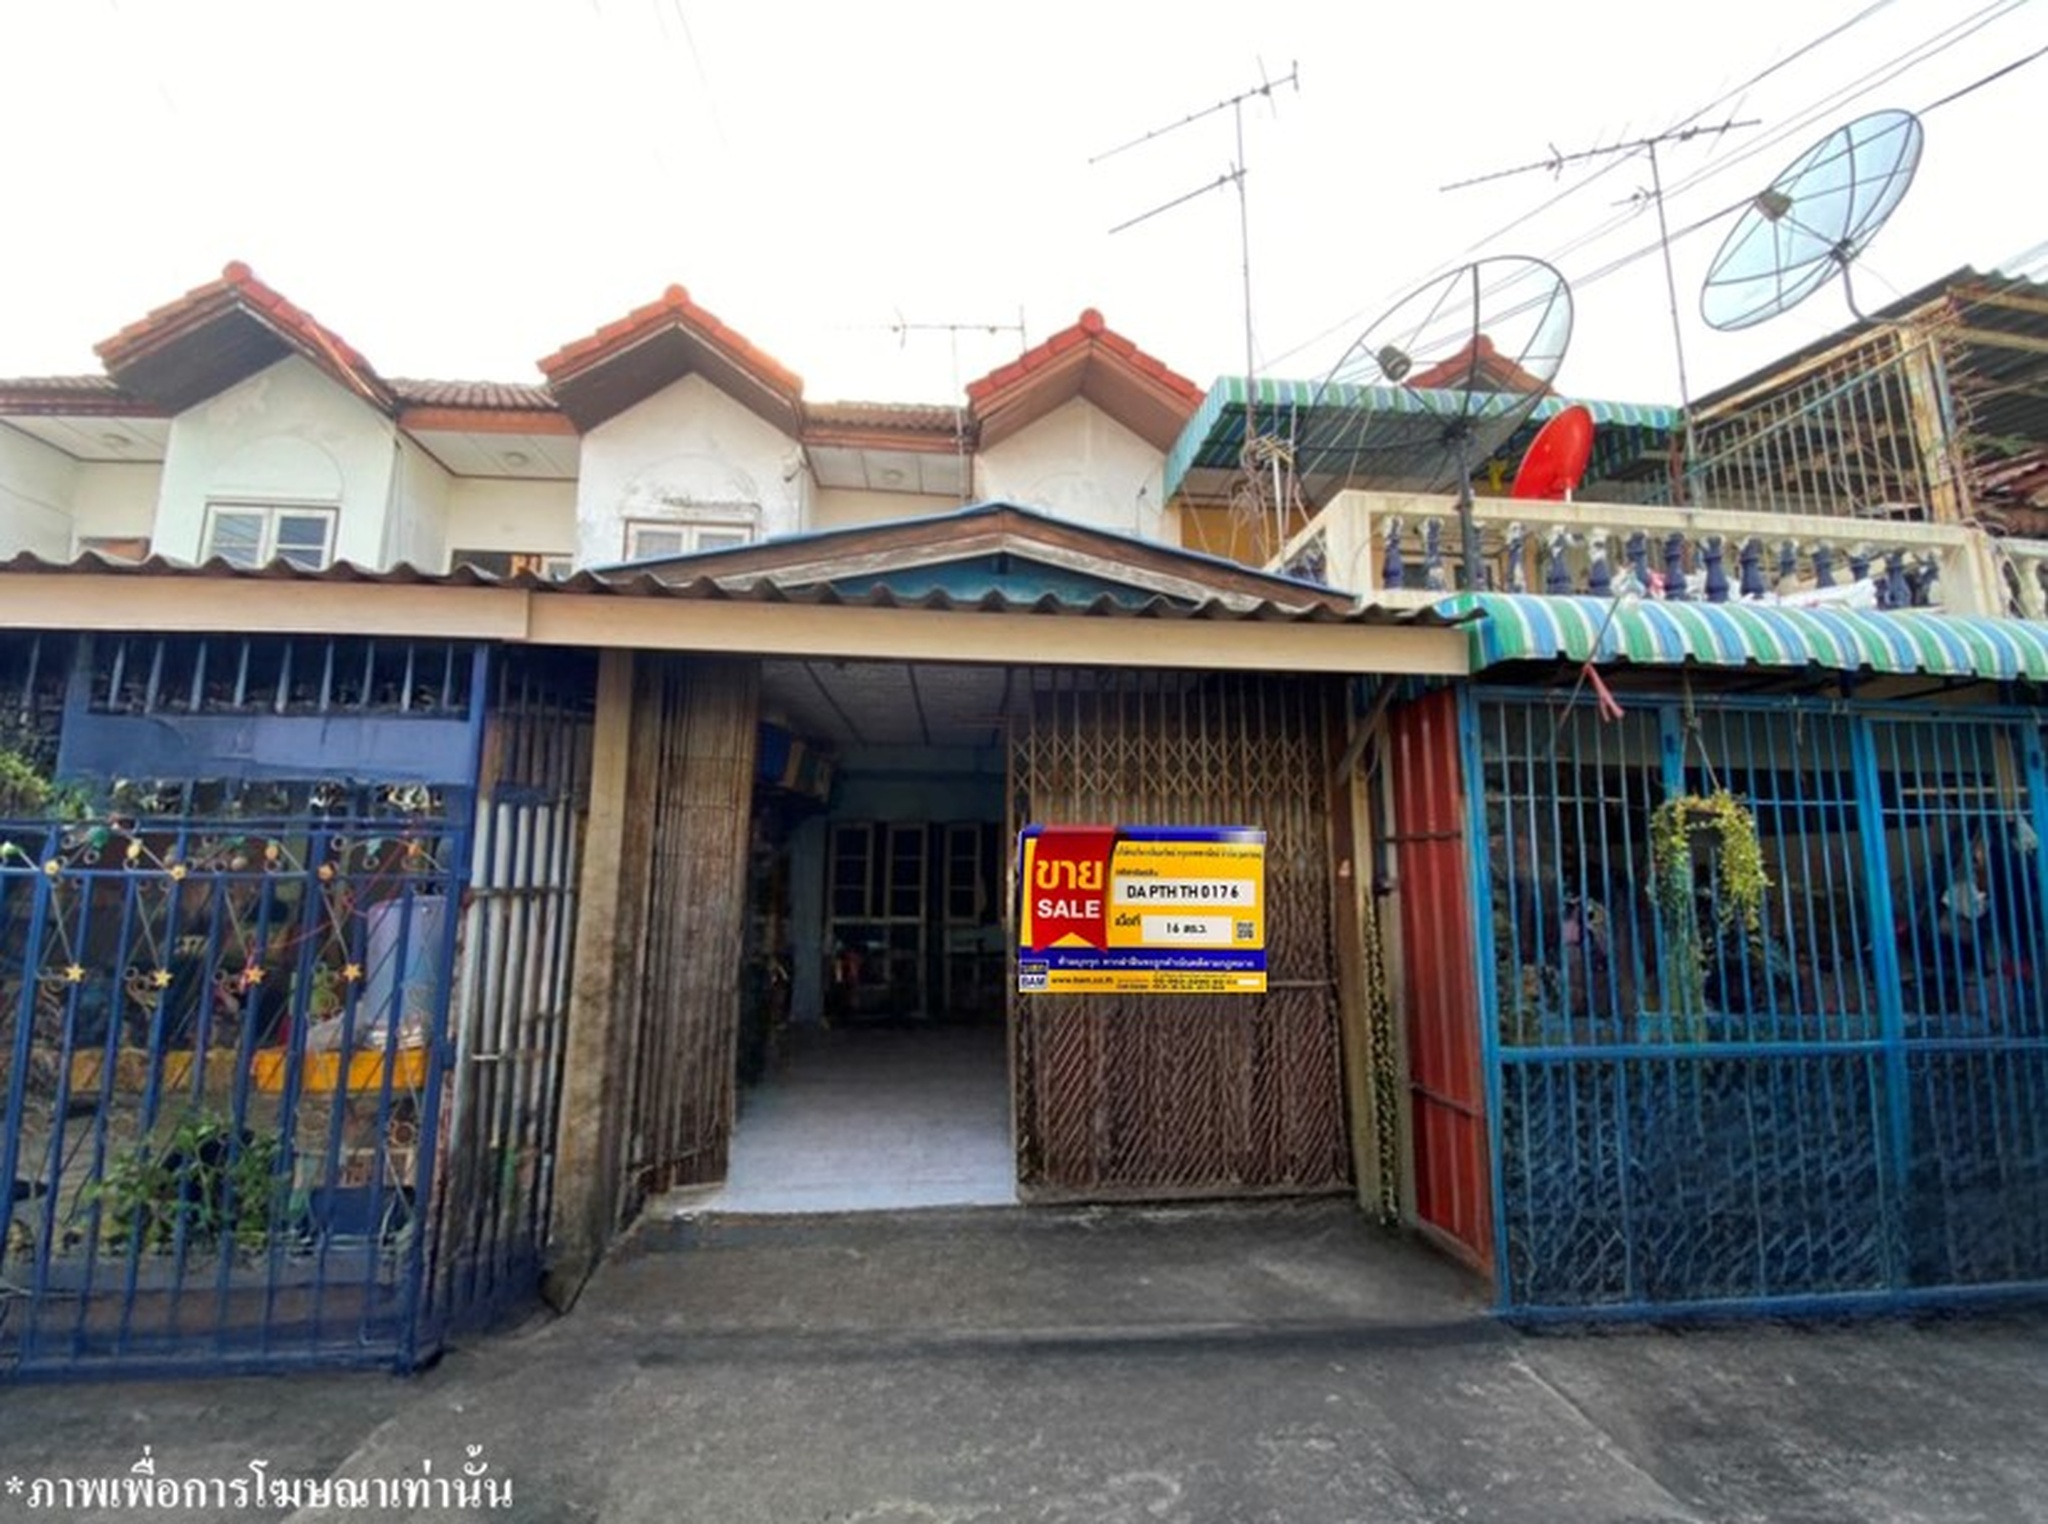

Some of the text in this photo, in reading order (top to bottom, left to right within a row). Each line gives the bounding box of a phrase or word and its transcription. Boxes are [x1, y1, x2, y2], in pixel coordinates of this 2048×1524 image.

[1036, 859, 1103, 890] ขาย
[1126, 885, 1240, 899] DA PTH TH 0176
[1037, 898, 1101, 918] SALE
[1166, 922, 1180, 934] 16
